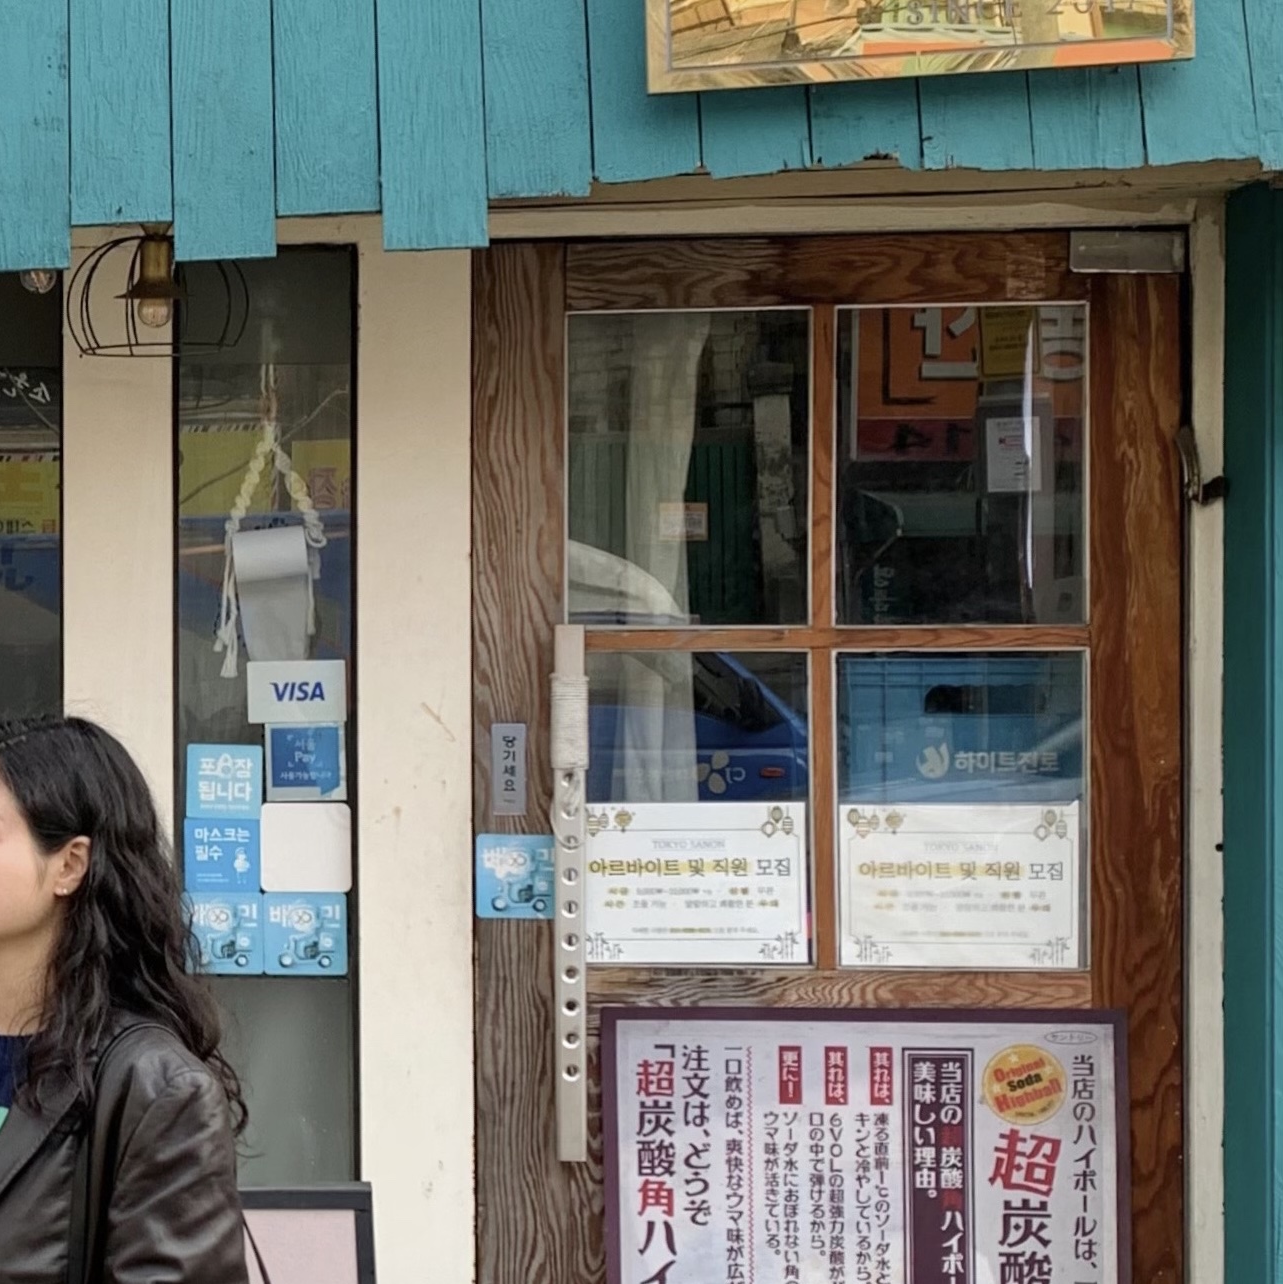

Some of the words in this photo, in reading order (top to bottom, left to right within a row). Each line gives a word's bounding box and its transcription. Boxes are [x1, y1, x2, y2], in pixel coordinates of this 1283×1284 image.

[906, 0, 1021, 25] SINCE
[269, 681, 325, 702] VISA
[199, 757, 253, 778] 포장
[294, 752, 316, 764] Pay
[502, 736, 517, 792] 당기세요
[199, 780, 253, 802] 됩니다
[194, 827, 251, 842] 마스크는
[194, 845, 223, 861] 필수
[589, 857, 681, 878] 아르바이트
[688, 858, 705, 877] 및
[712, 857, 748, 877] 직원
[755, 857, 791, 877] 모집
[858, 860, 953, 881] 아르바이트
[959, 861, 976, 880] 및
[984, 861, 1020, 881] 직원
[1028, 861, 1064, 881] 모집
[782, 1051, 799, 1098] 更に!
[828, 1051, 845, 1103] 其れは、
[873, 1052, 891, 1104] 其れは、
[994, 1056, 1046, 1083] Original
[1006, 1071, 1043, 1092] Soda
[994, 1077, 1062, 1113] Highball
[681, 1044, 712, 1227] 注文は、どうぞ
[913, 1061, 938, 1199] 美味しい理由。
[763, 1112, 782, 1256] ウマ味が活きている。
[808, 1113, 826, 1257] 口の中で弾けるから。
